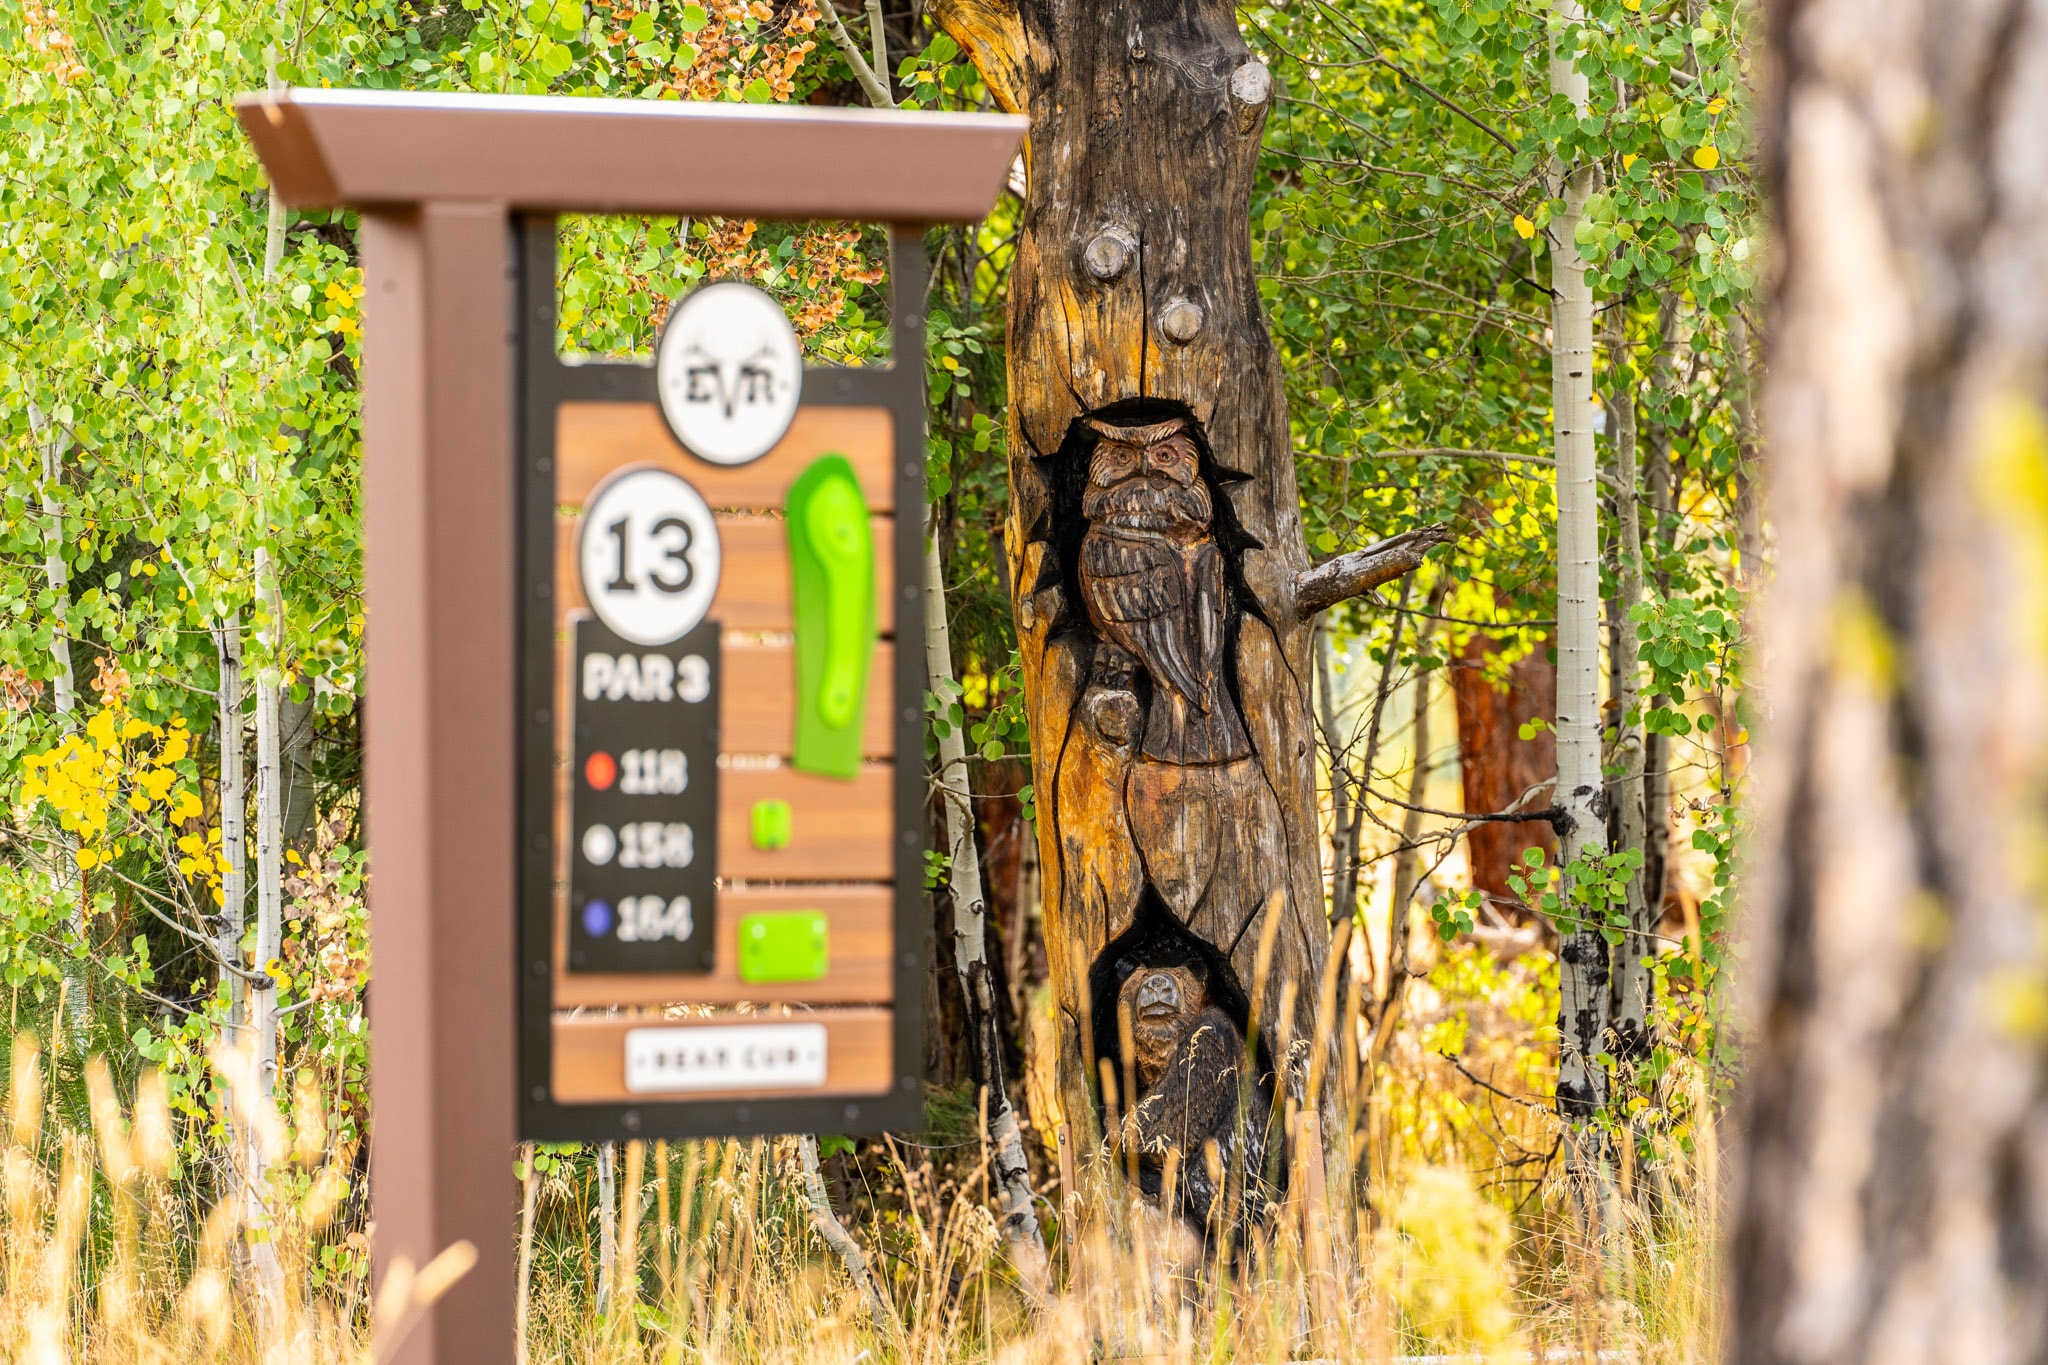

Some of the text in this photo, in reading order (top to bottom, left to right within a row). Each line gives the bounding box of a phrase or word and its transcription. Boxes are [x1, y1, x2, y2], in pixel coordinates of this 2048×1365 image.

[608, 518, 694, 593] 13
[583, 653, 711, 703] PAR 3
[620, 748, 688, 795] 118
[618, 822, 694, 868] 158
